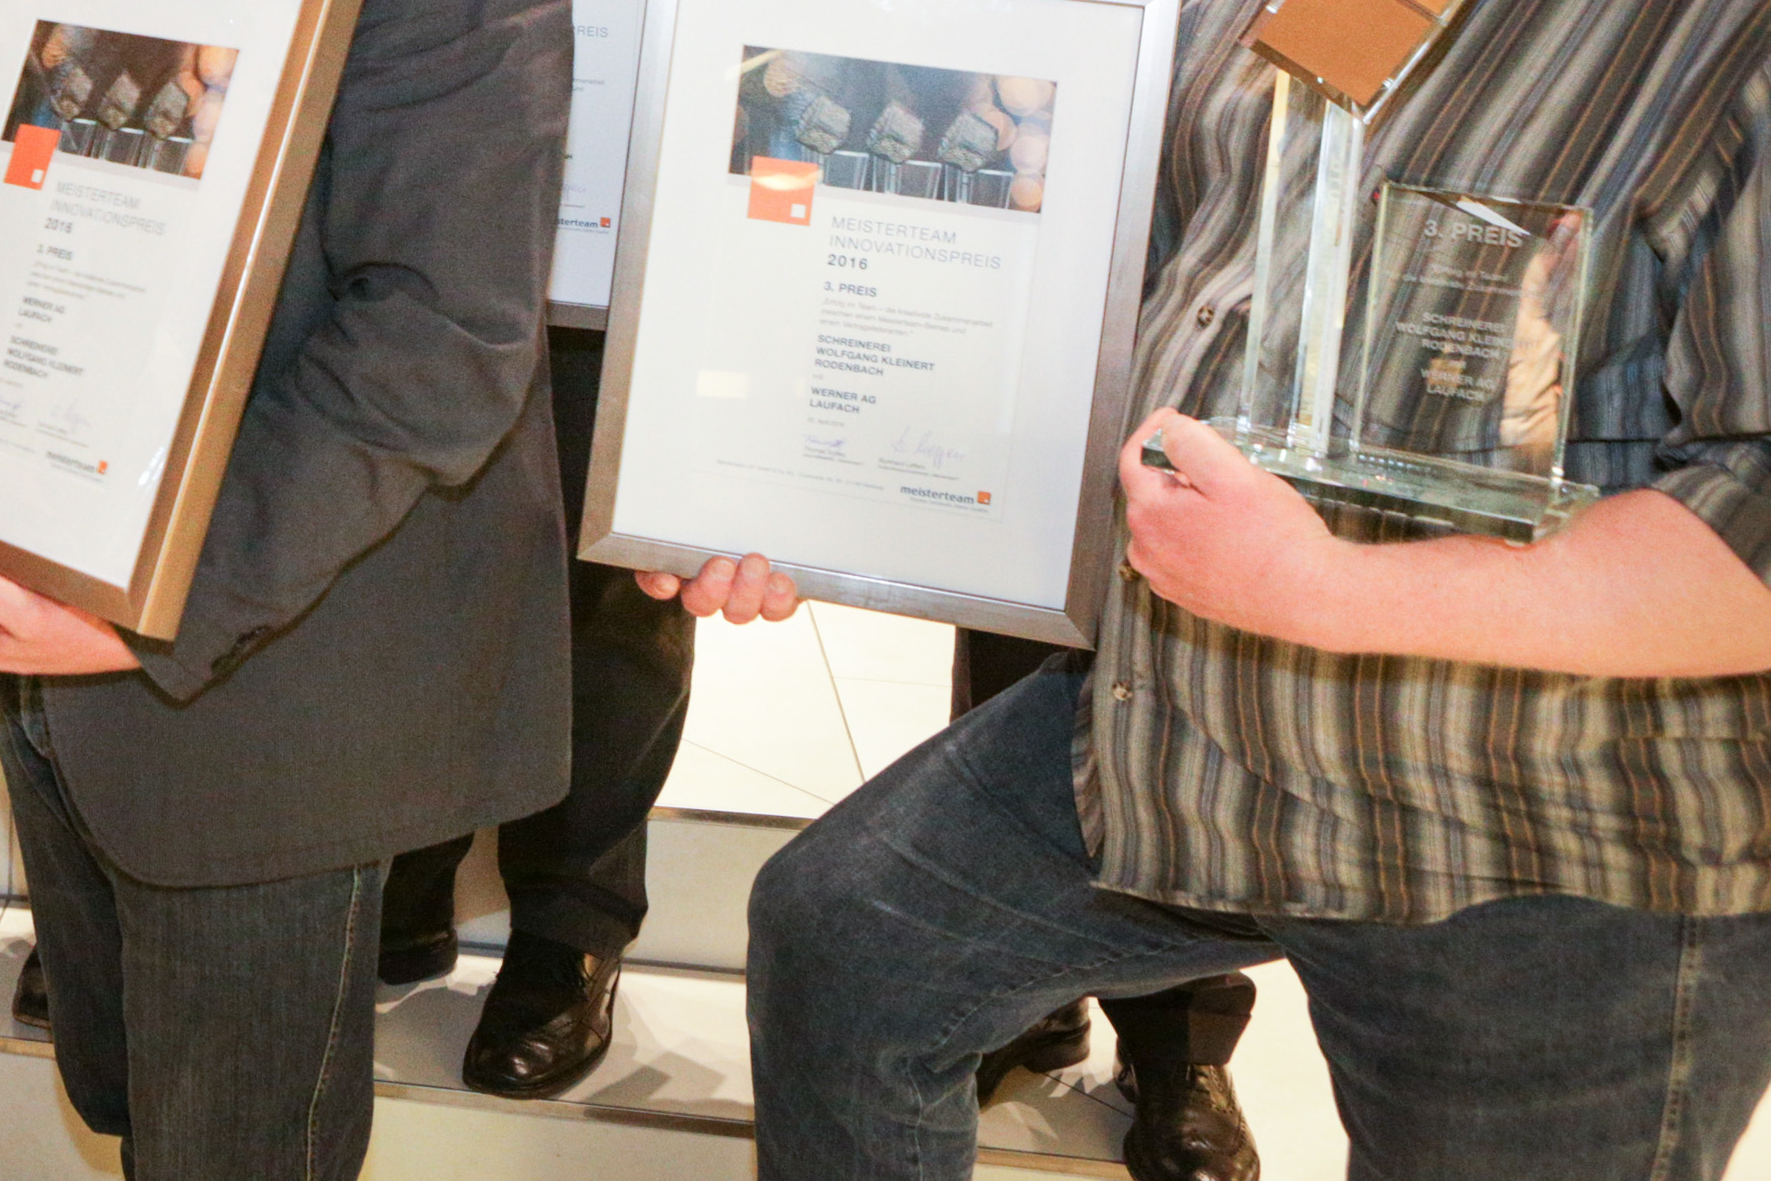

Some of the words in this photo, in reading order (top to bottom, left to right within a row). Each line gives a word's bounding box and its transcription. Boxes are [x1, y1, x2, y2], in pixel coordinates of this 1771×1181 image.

[56, 180, 141, 210] MEISTERTEAM
[44, 217, 74, 235] 2016
[50, 199, 166, 236] INNOVATIONSPREIS
[831, 215, 957, 245] MEISTERTEAM
[1423, 219, 1443, 238] 3.
[1451, 222, 1524, 249] PREIS
[46, 245, 74, 261] PREIS
[827, 254, 869, 270] 2016
[829, 235, 1002, 270] INNOVATIONSPREIS
[823, 281, 834, 292] 3.
[838, 282, 878, 298] PREIS
[817, 334, 892, 353] SCHREINEREI
[814, 358, 885, 377] RODENBACH
[815, 346, 879, 364] WOLFGANG
[880, 356, 936, 372] KLEINERT
[810, 387, 858, 402] WERNER
[860, 394, 877, 405] AG
[809, 399, 860, 414] LAUFACH
[900, 485, 975, 505] meisterteam
